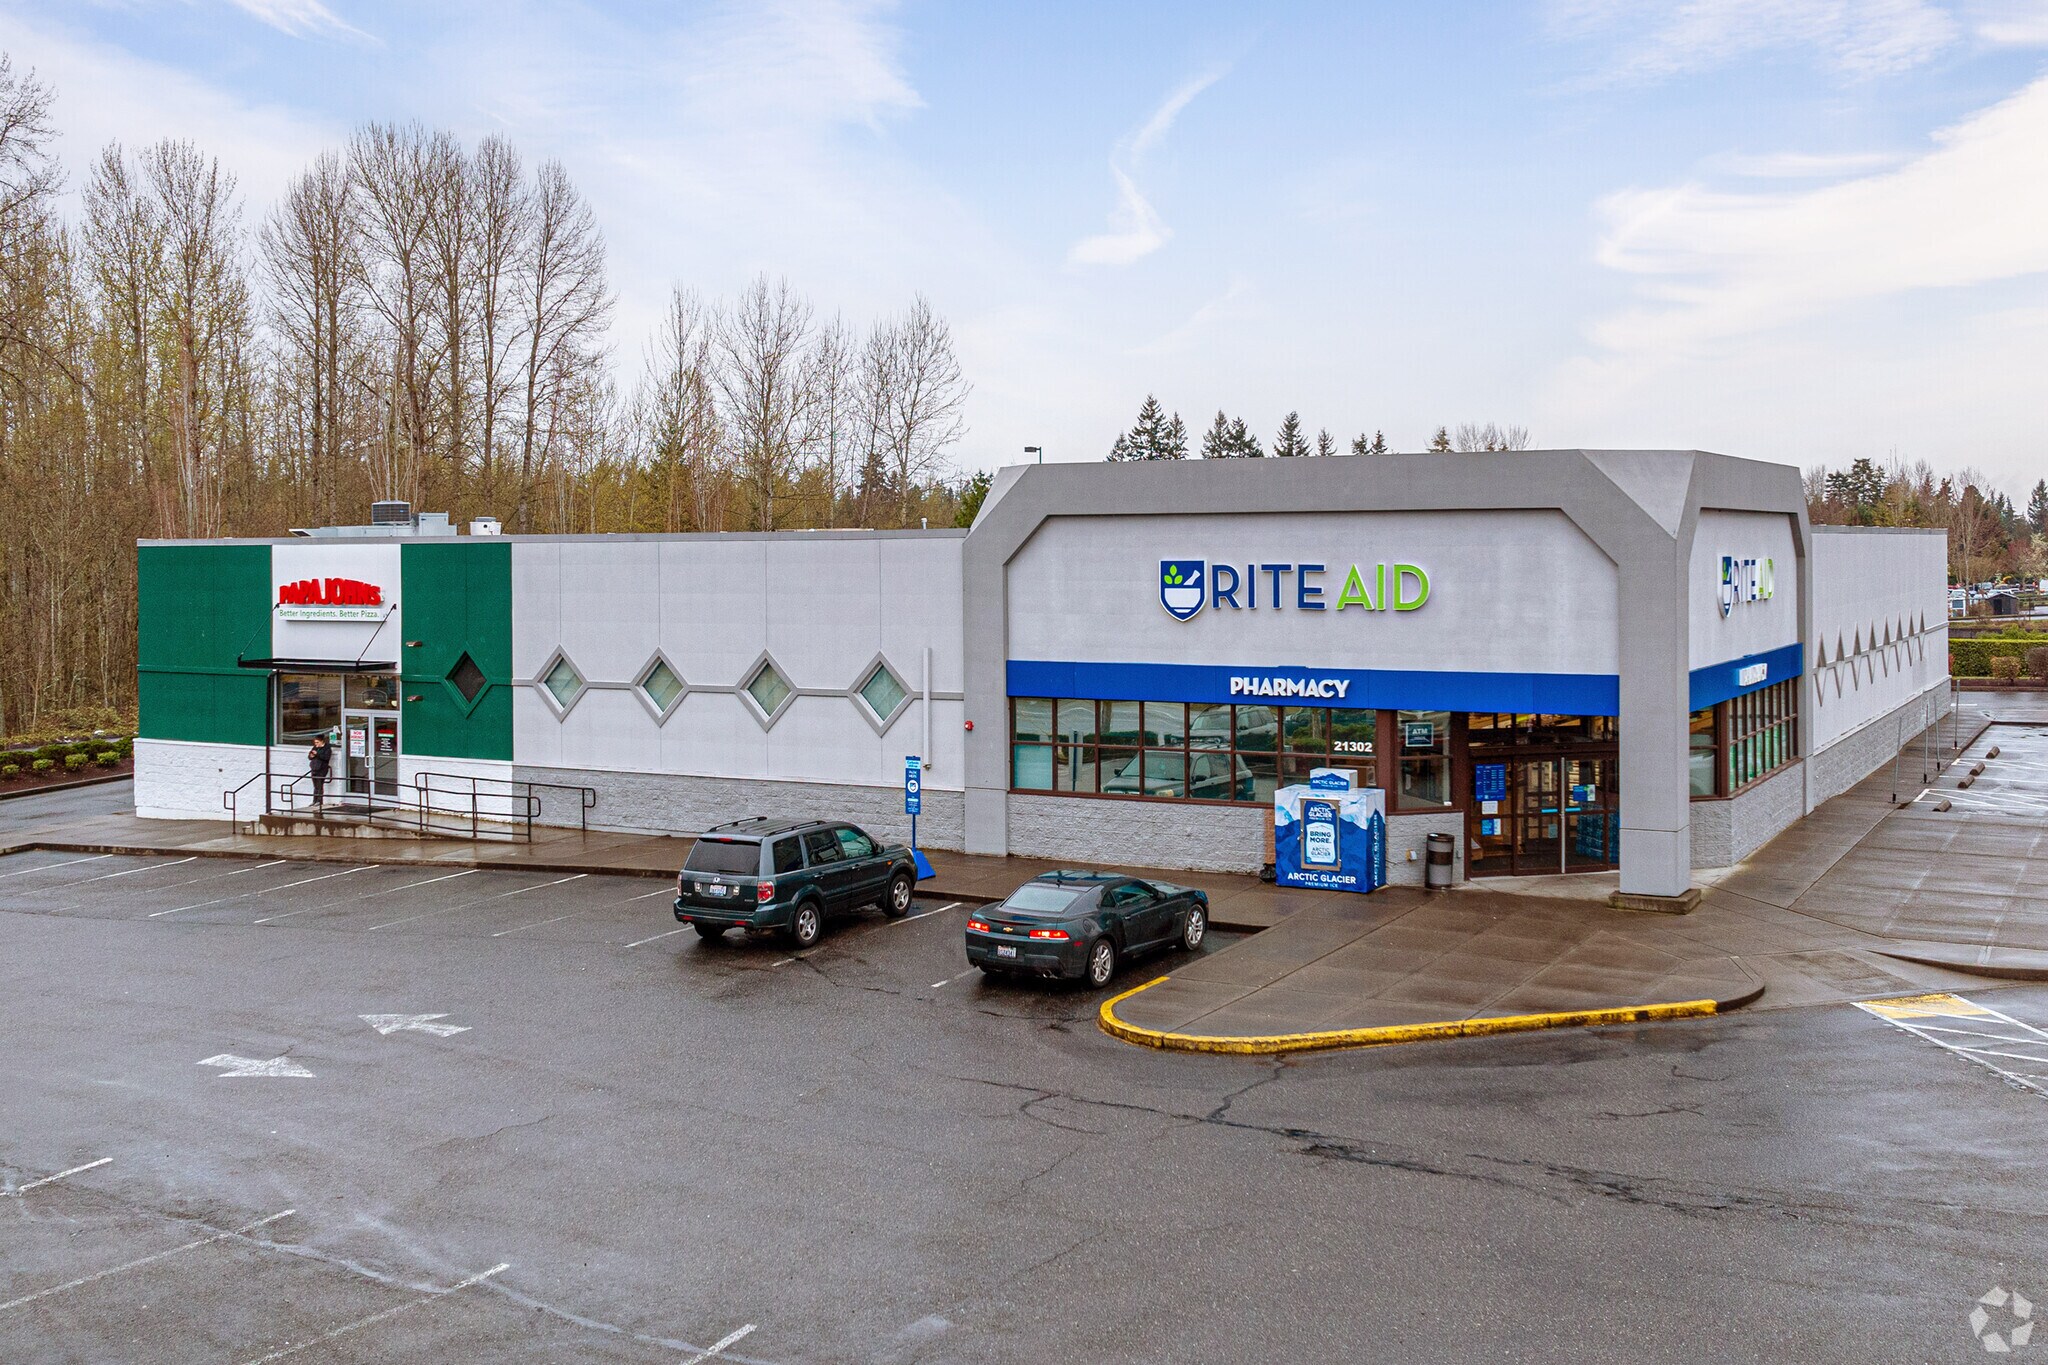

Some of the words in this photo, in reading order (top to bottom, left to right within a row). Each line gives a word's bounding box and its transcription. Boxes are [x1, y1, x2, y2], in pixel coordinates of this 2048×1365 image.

[1211, 564, 1327, 610] RITE
[1335, 563, 1431, 611] AID
[1732, 559, 1756, 604] RITE
[1756, 558, 1773, 601] AID
[279, 579, 321, 605] PAPA
[279, 609, 298, 617] Better
[300, 609, 337, 619] Ingredients.
[339, 609, 359, 618] Better
[361, 609, 379, 618] Pizza.
[1230, 677, 1350, 698] PHARMACY
[1412, 727, 1428, 735] ATM
[1333, 740, 1373, 753] 21302
[1288, 872, 1318, 882] ARCTIC
[1320, 874, 1357, 885] GLACIER
